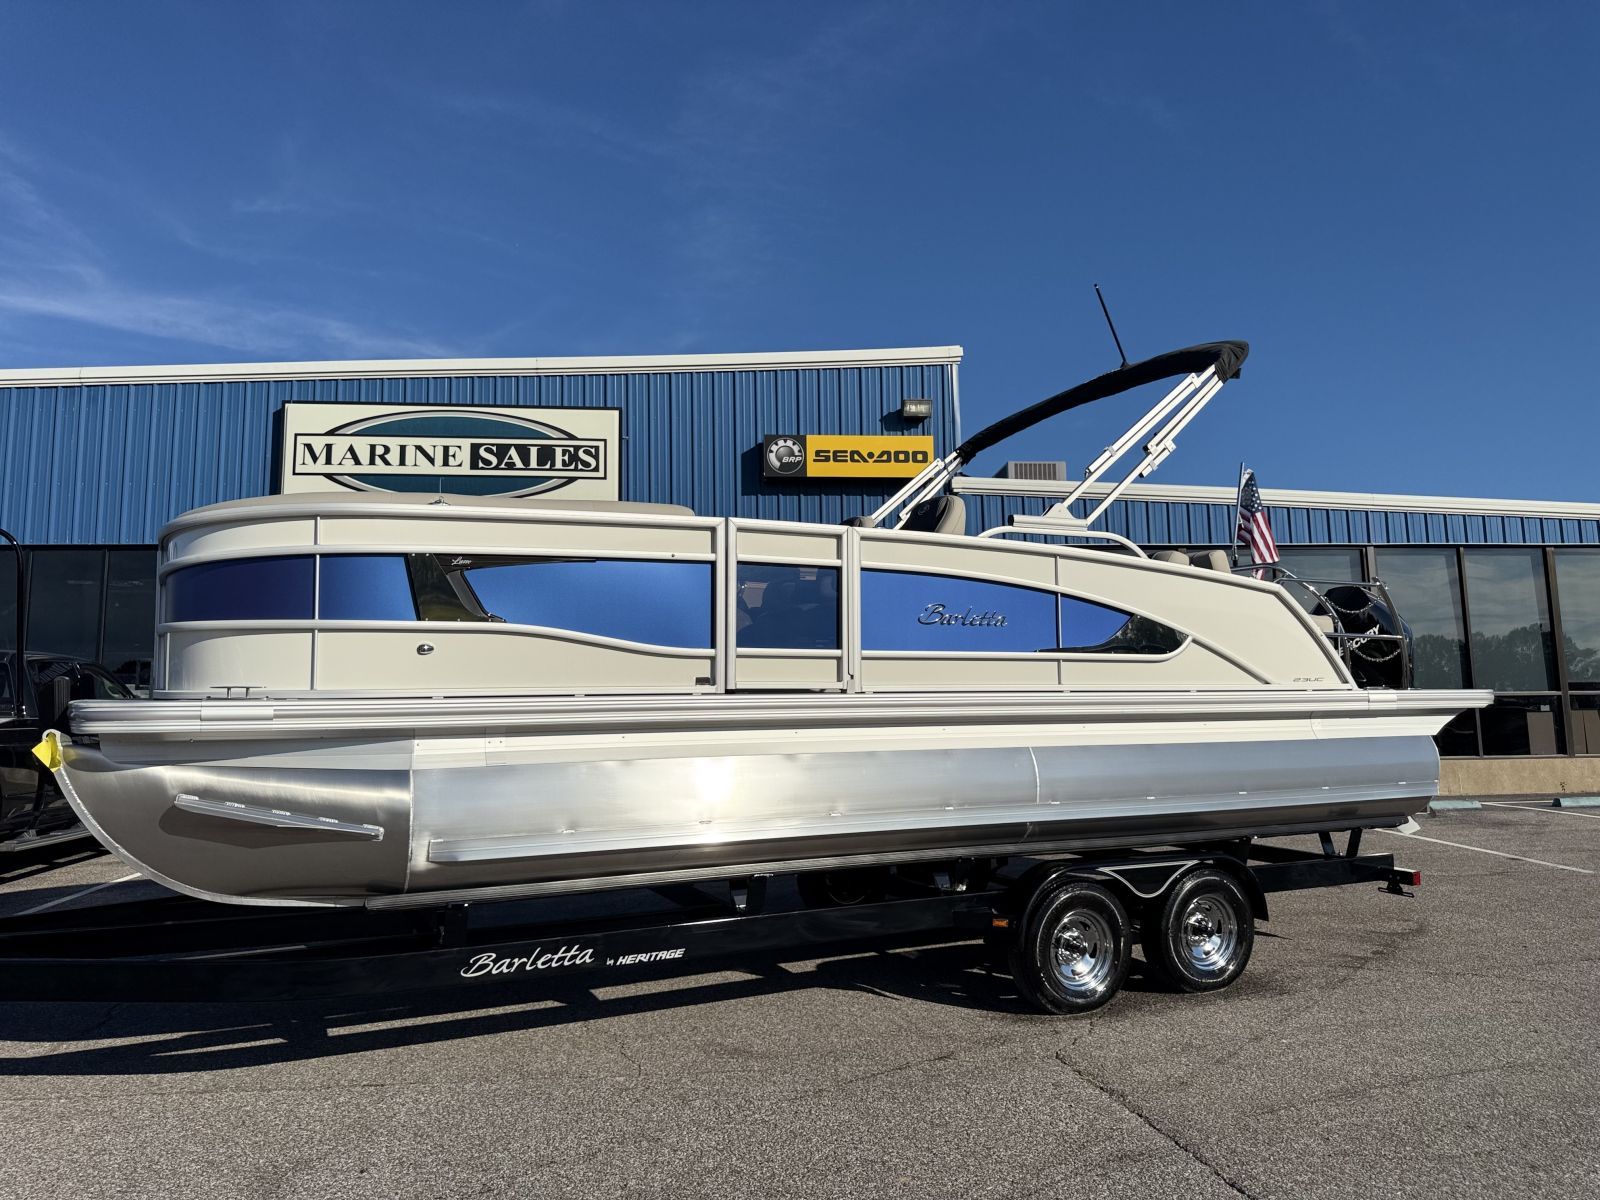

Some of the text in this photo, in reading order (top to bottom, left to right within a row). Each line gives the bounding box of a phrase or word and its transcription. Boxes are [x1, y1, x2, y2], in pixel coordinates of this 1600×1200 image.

[299, 442, 598, 472] MARINE SALES
[917, 603, 1008, 627] Barletta
[460, 944, 594, 978] Barletta
[615, 948, 686, 966] HERITAGE
